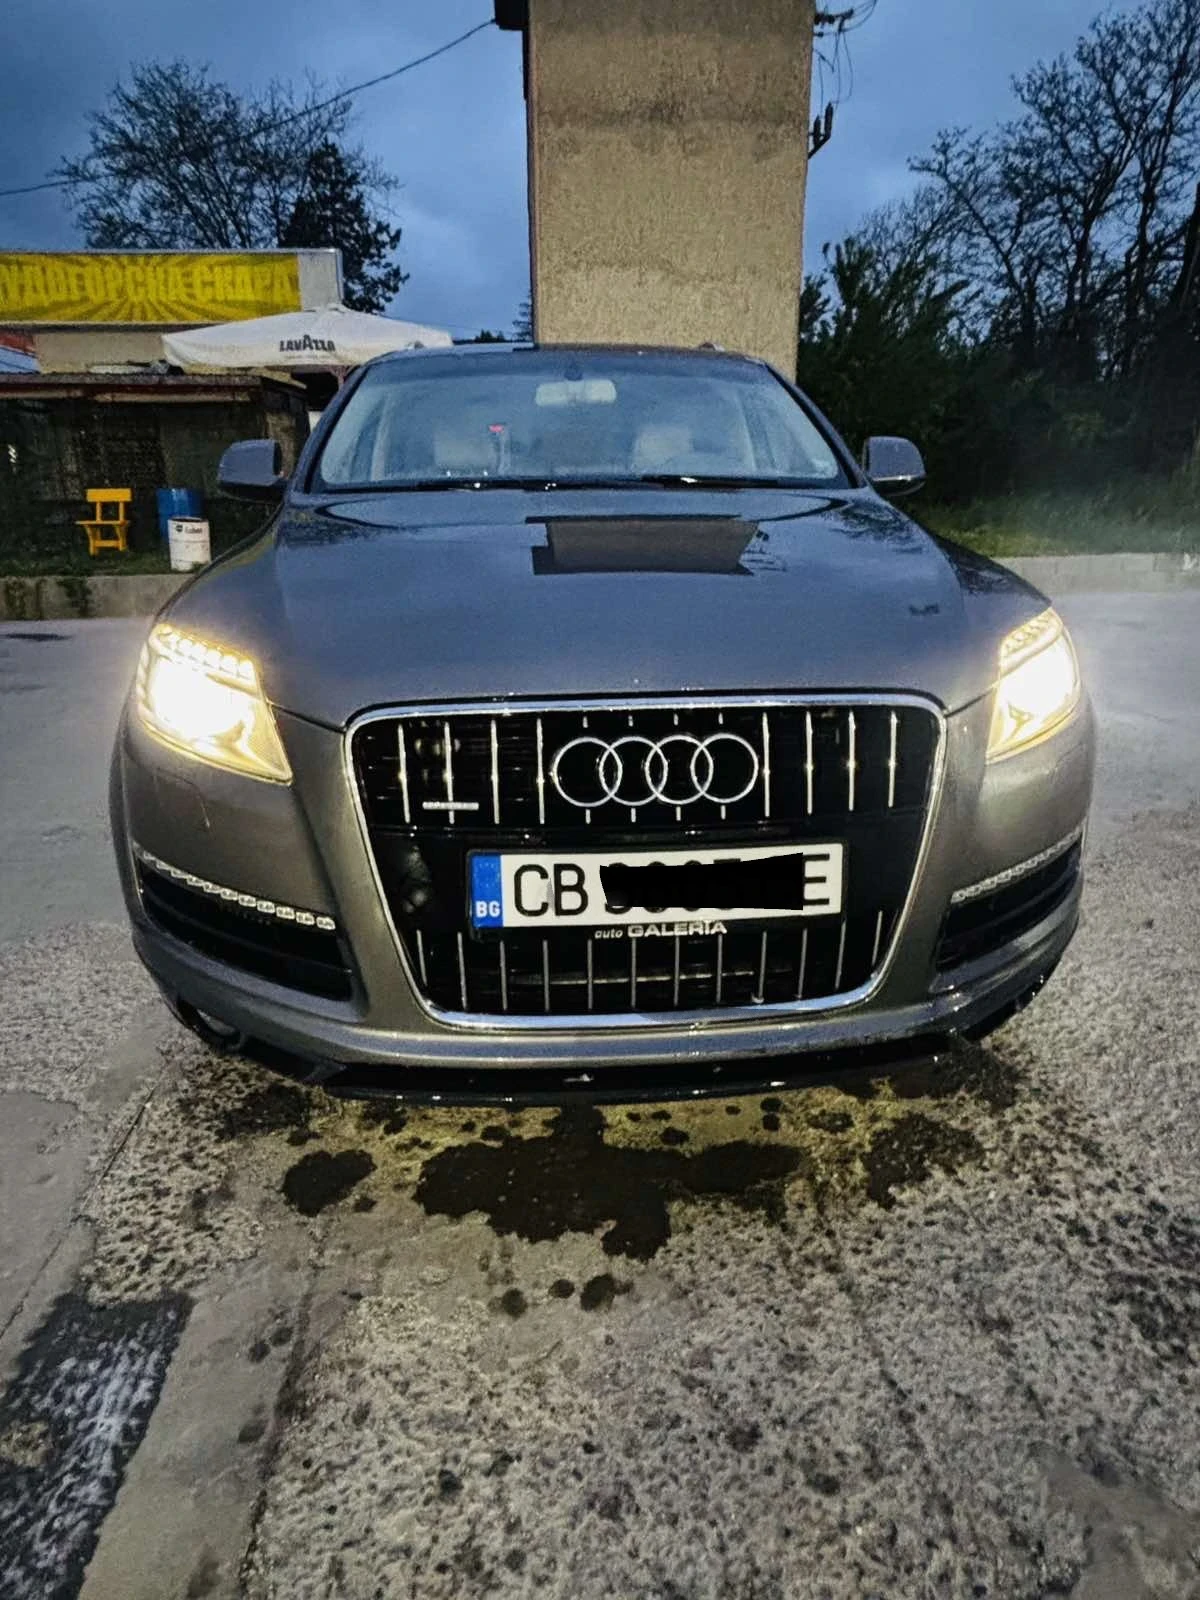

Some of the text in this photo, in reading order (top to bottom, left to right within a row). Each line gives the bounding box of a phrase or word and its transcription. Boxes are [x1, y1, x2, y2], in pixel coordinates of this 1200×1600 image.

[279, 334, 336, 352] LAVAZZA
[513, 863, 589, 917] CB
[475, 900, 501, 918] BG
[594, 920, 728, 939] auto GALERIA
